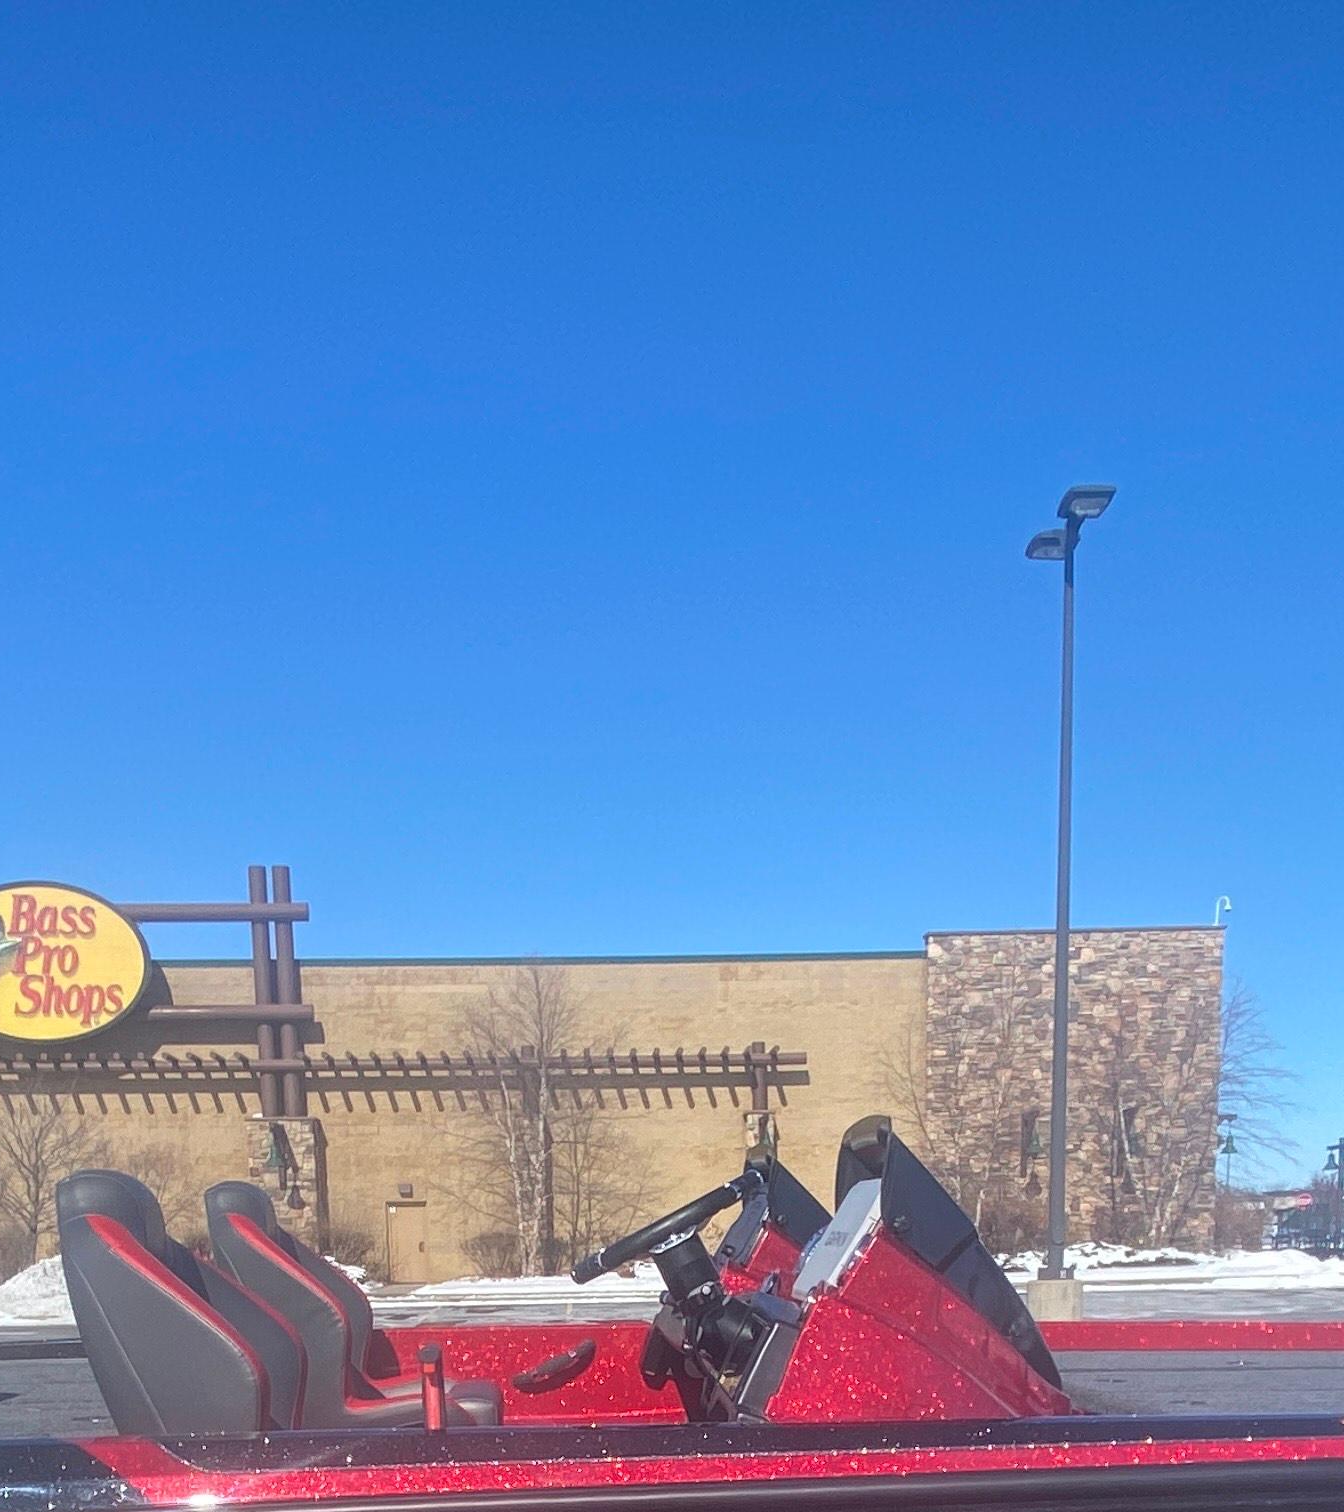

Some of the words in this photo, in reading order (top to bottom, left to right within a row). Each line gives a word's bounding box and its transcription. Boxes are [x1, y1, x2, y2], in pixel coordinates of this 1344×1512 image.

[7, 894, 97, 938] Bass
[12, 936, 79, 977] Pro
[14, 974, 124, 1028] Shops
